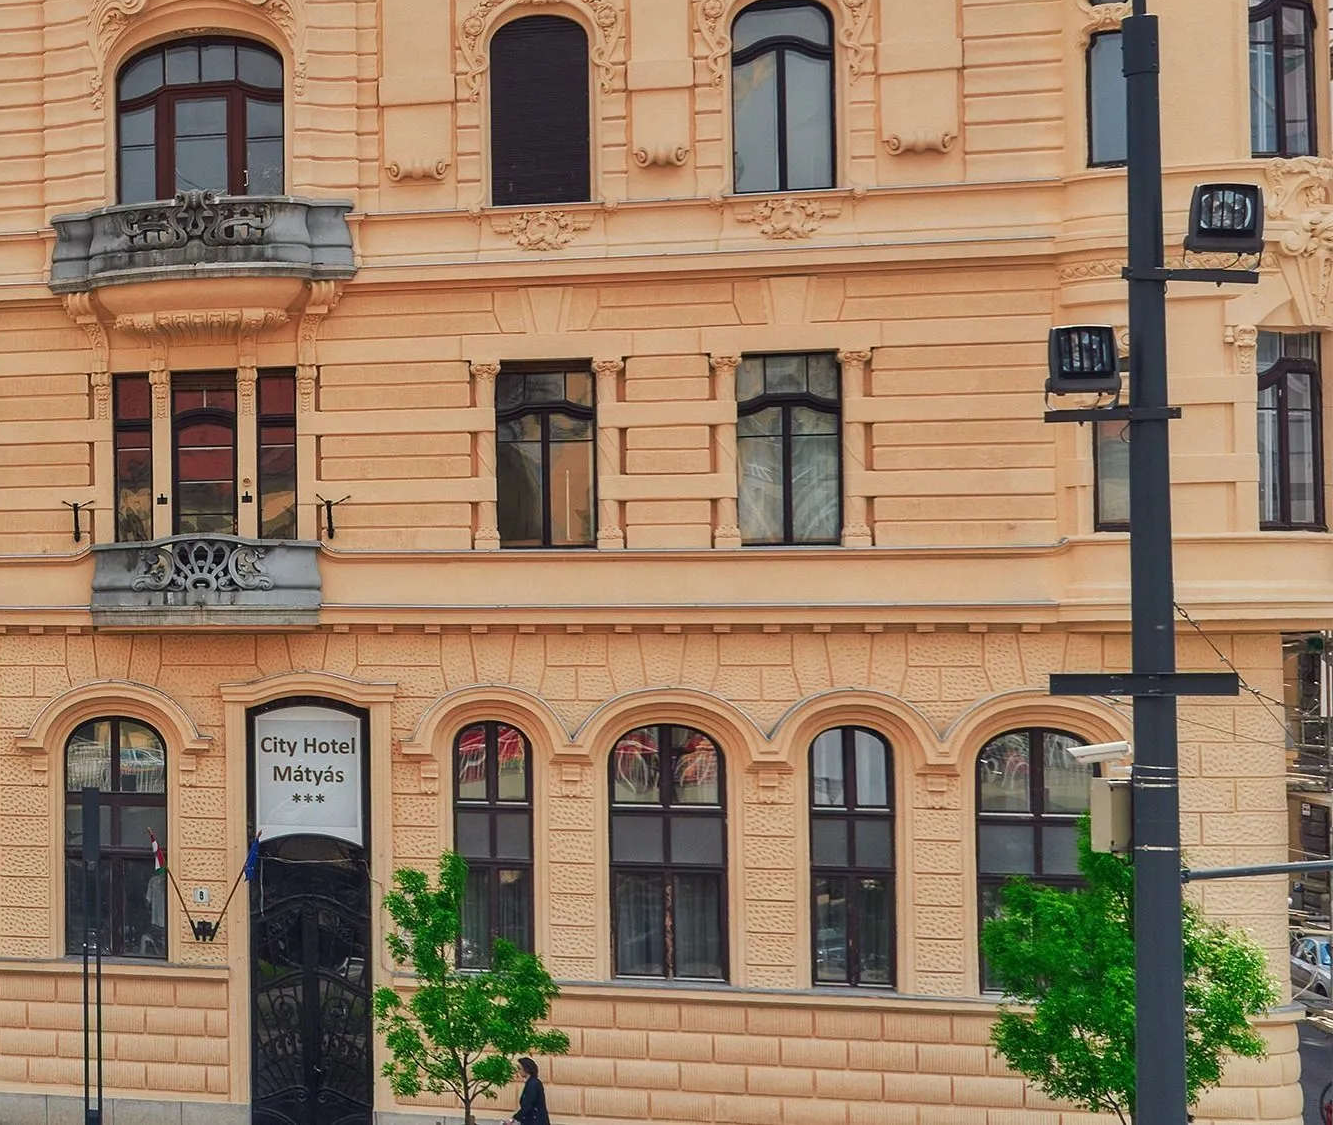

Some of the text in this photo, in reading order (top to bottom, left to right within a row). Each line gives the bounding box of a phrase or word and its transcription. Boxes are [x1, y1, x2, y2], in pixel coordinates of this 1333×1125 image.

[260, 736, 356, 757] City Hotel
[273, 764, 345, 786] Mátyás
